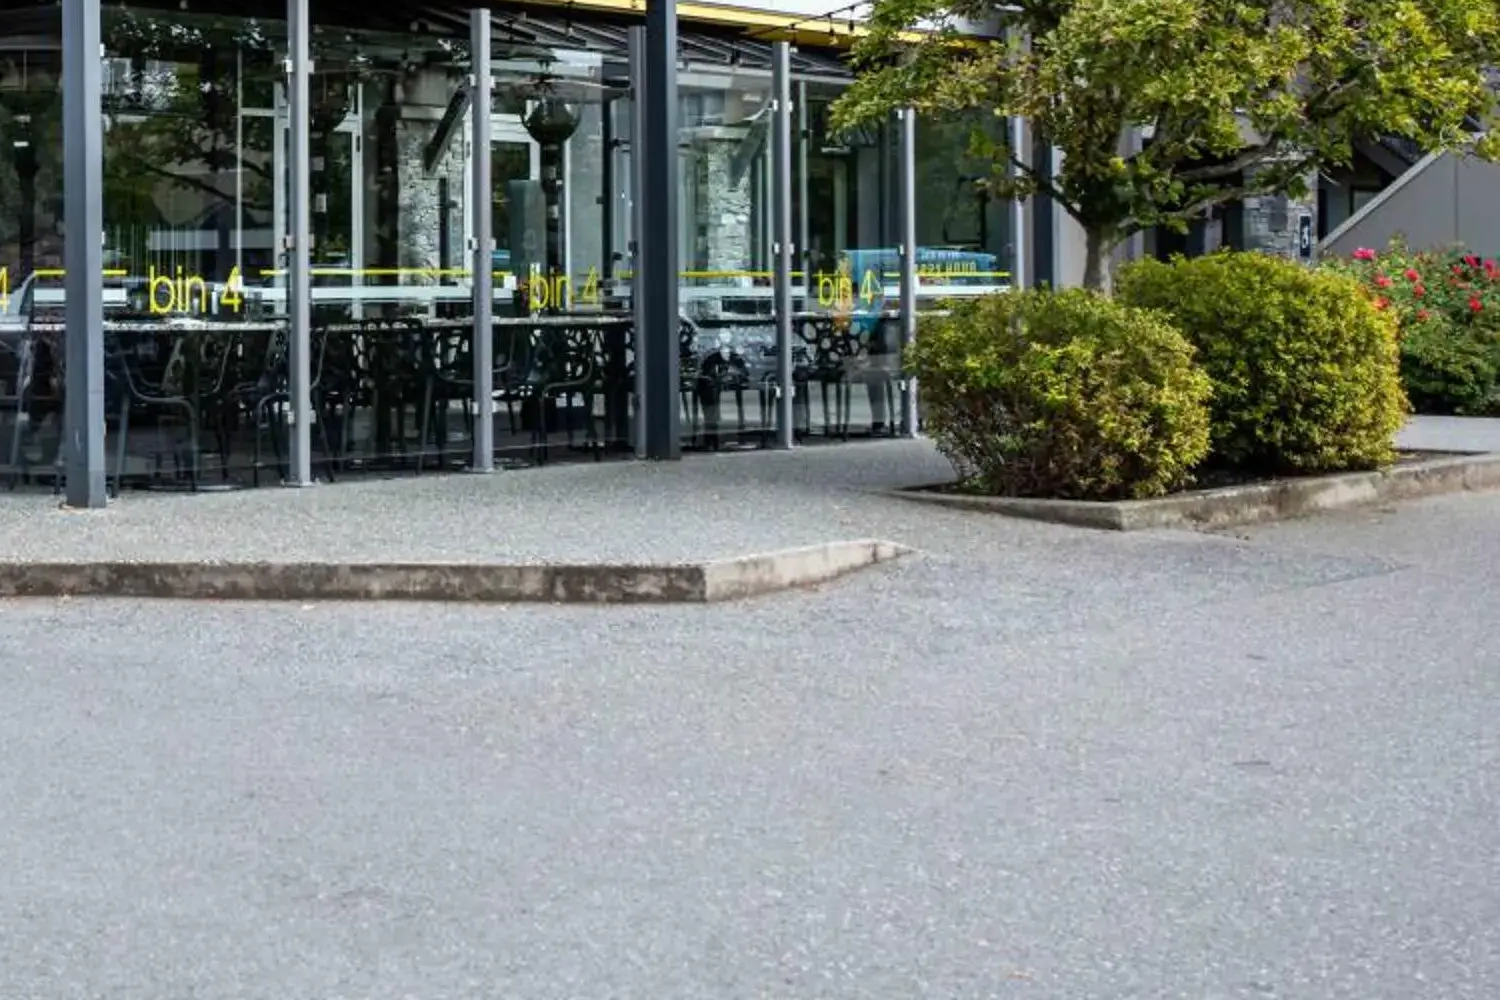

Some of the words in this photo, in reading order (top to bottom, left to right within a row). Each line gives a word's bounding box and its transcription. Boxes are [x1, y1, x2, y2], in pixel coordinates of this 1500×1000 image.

[150, 265, 206, 314] bin
[220, 265, 242, 313] 4
[529, 263, 570, 311] bin
[583, 264, 599, 306] 4
[819, 270, 852, 306] bin
